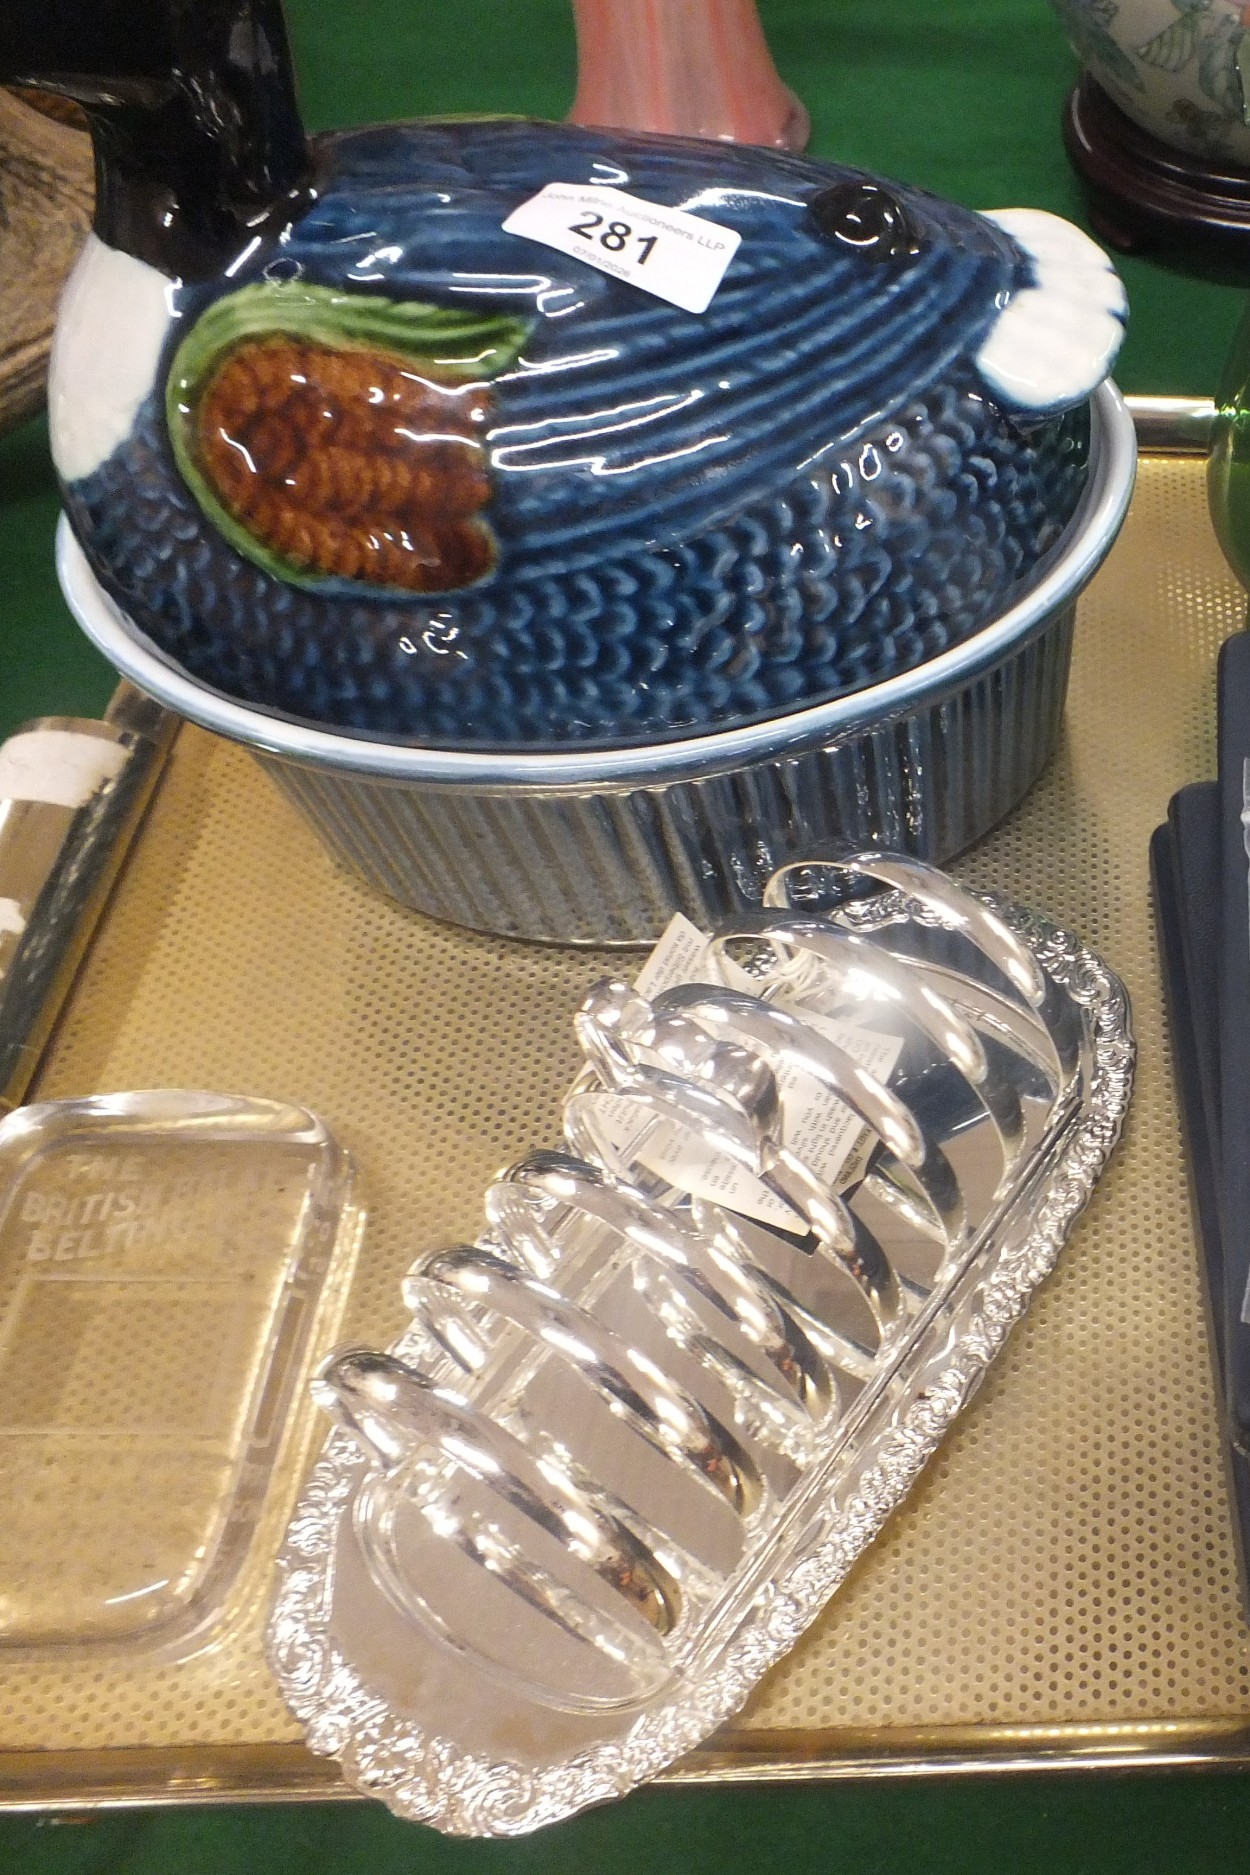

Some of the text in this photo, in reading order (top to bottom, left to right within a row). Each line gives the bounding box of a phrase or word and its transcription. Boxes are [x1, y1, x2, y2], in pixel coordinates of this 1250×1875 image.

[567, 210, 659, 265] 281
[617, 205, 695, 241] Auctioneers
[697, 235, 726, 251] LLP
